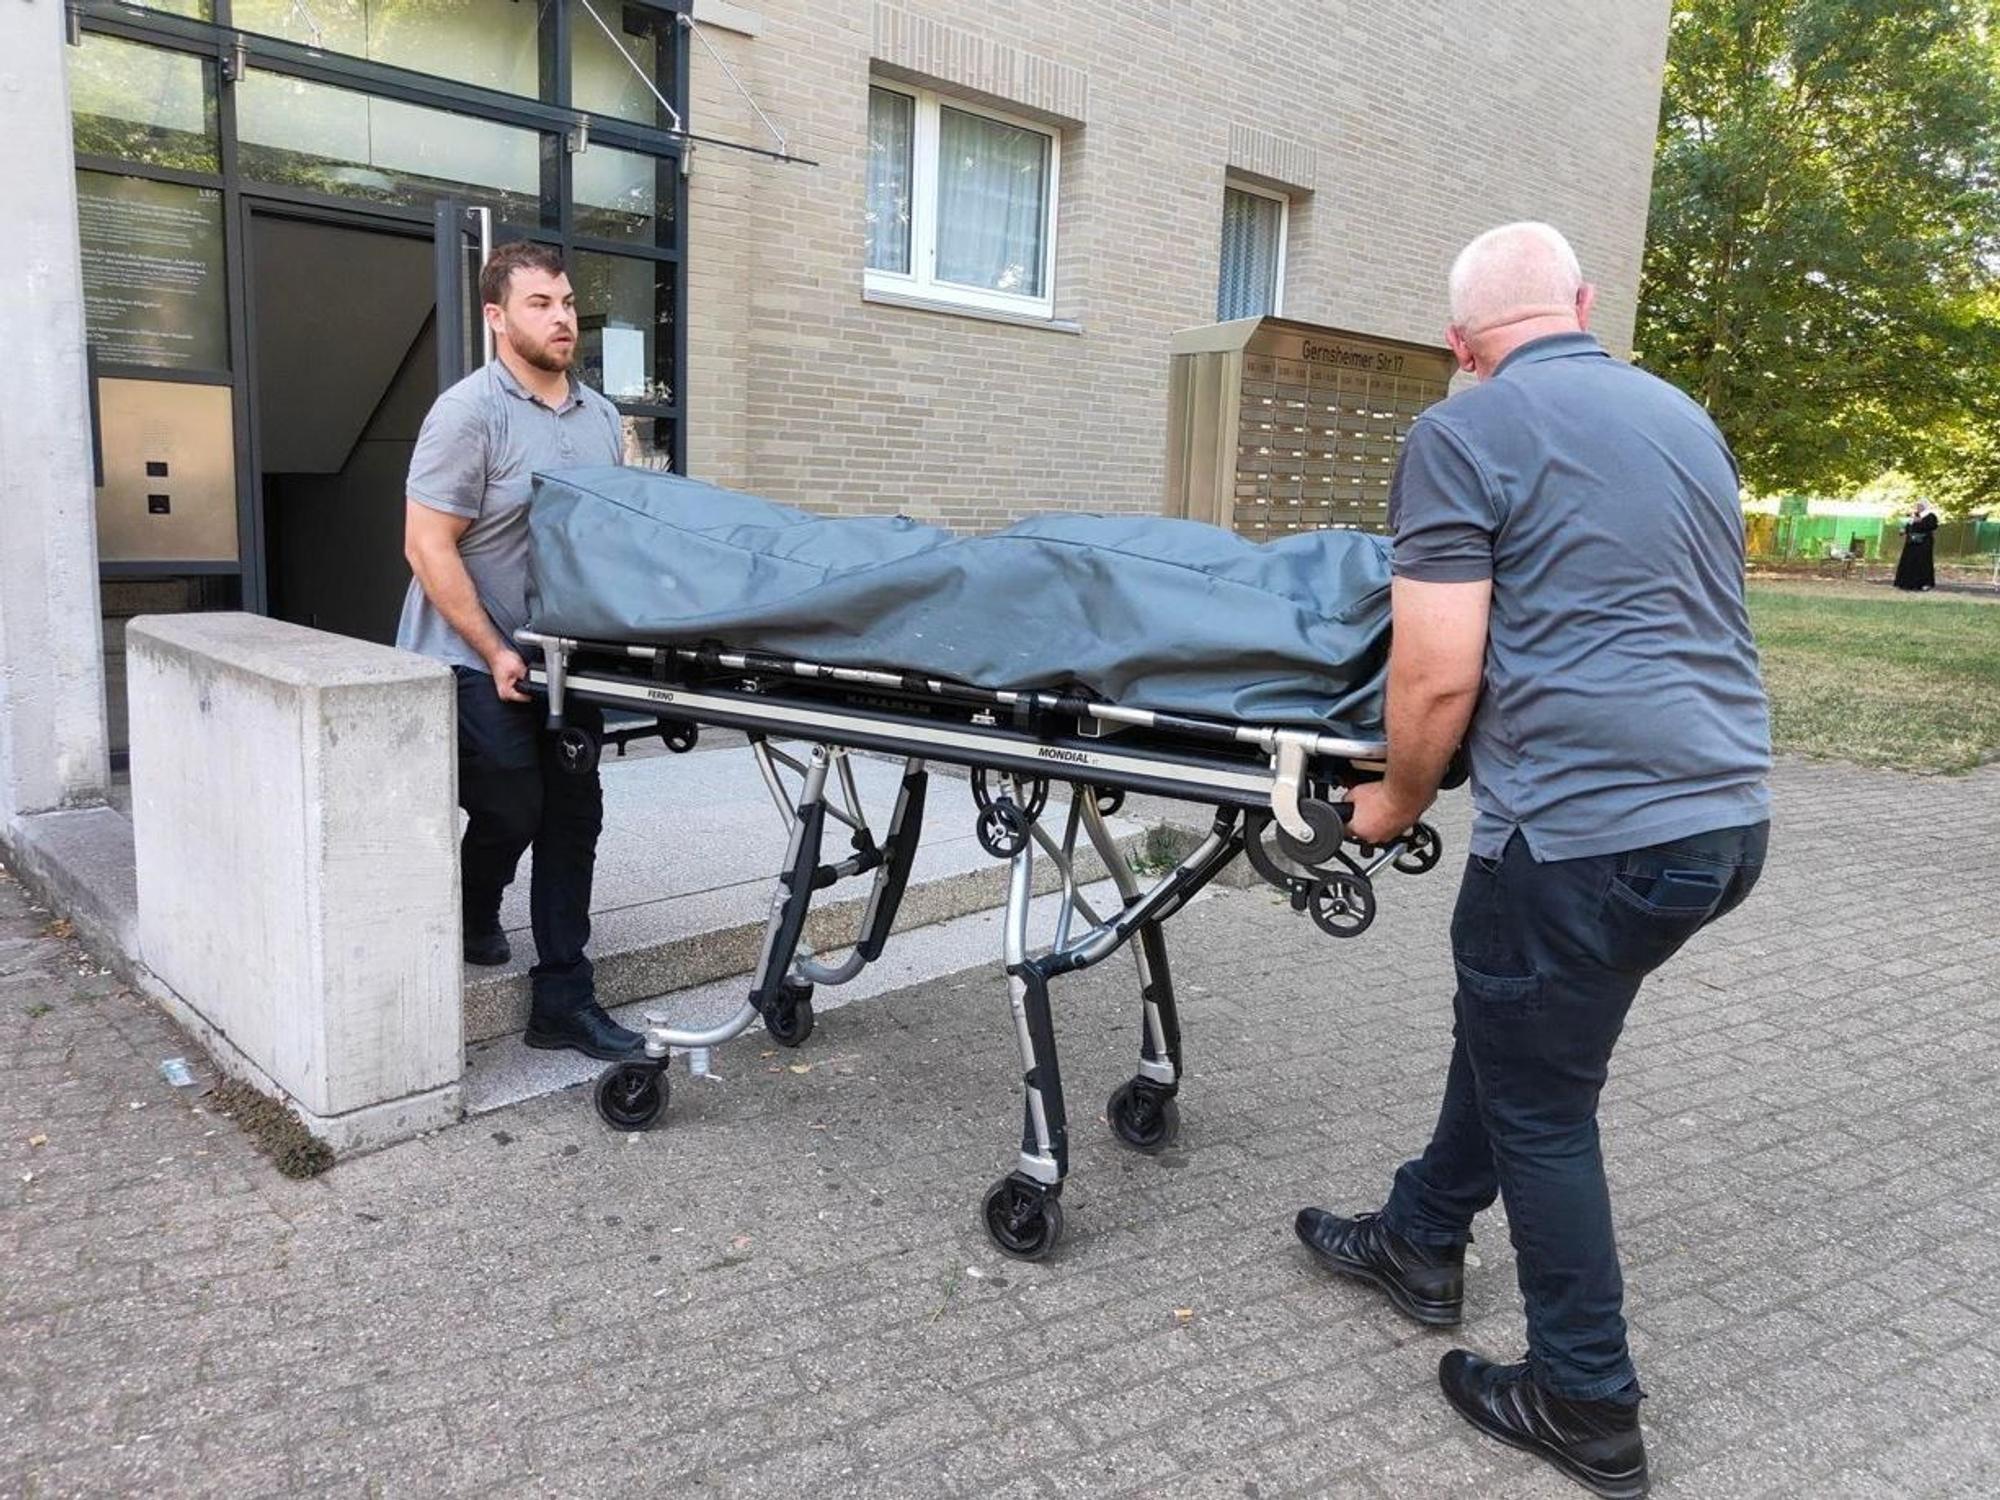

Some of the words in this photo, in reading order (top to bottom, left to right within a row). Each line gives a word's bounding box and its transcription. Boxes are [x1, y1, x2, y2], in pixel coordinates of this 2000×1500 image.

[1302, 340, 1374, 369] Gernsheimer
[648, 689, 674, 701] FERNO
[1038, 747, 1089, 764] MONDIAL
